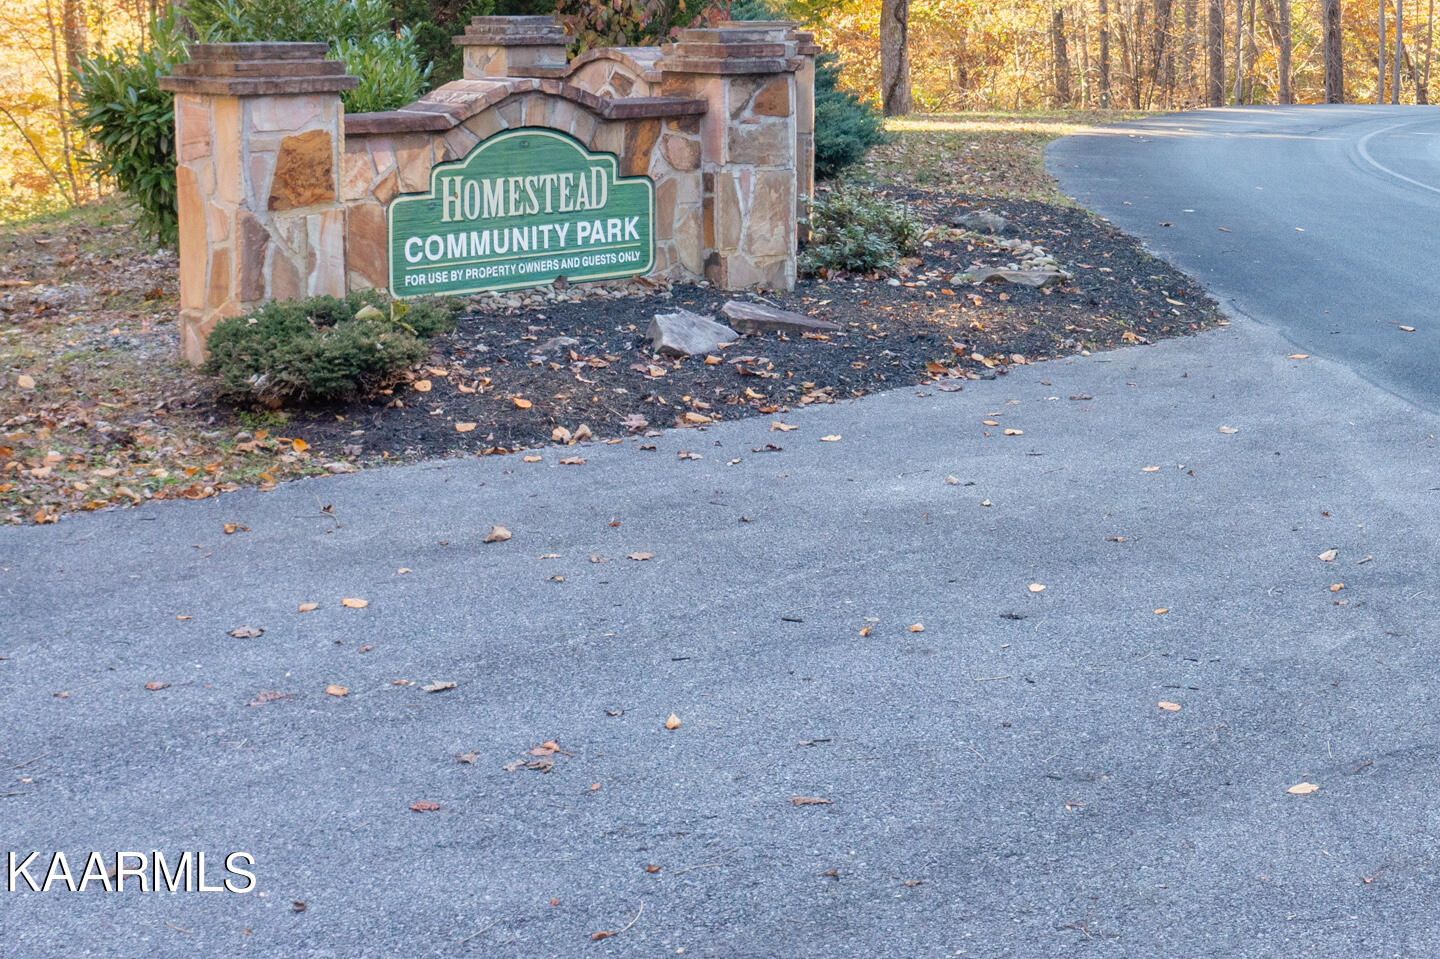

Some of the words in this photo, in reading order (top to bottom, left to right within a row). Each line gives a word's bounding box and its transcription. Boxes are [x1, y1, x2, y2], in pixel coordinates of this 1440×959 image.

[440, 166, 608, 223] HOMESTEAD
[404, 222, 570, 264] COMMUNITY
[577, 216, 640, 246] PARK
[405, 274, 426, 287] FOR
[428, 272, 449, 284] USE
[450, 270, 464, 282] BY
[465, 265, 516, 280] PROPERTY
[518, 260, 559, 274] OWNERS
[561, 257, 581, 270] AND
[582, 253, 617, 267] GUESTS
[618, 251, 641, 264] ONLY
